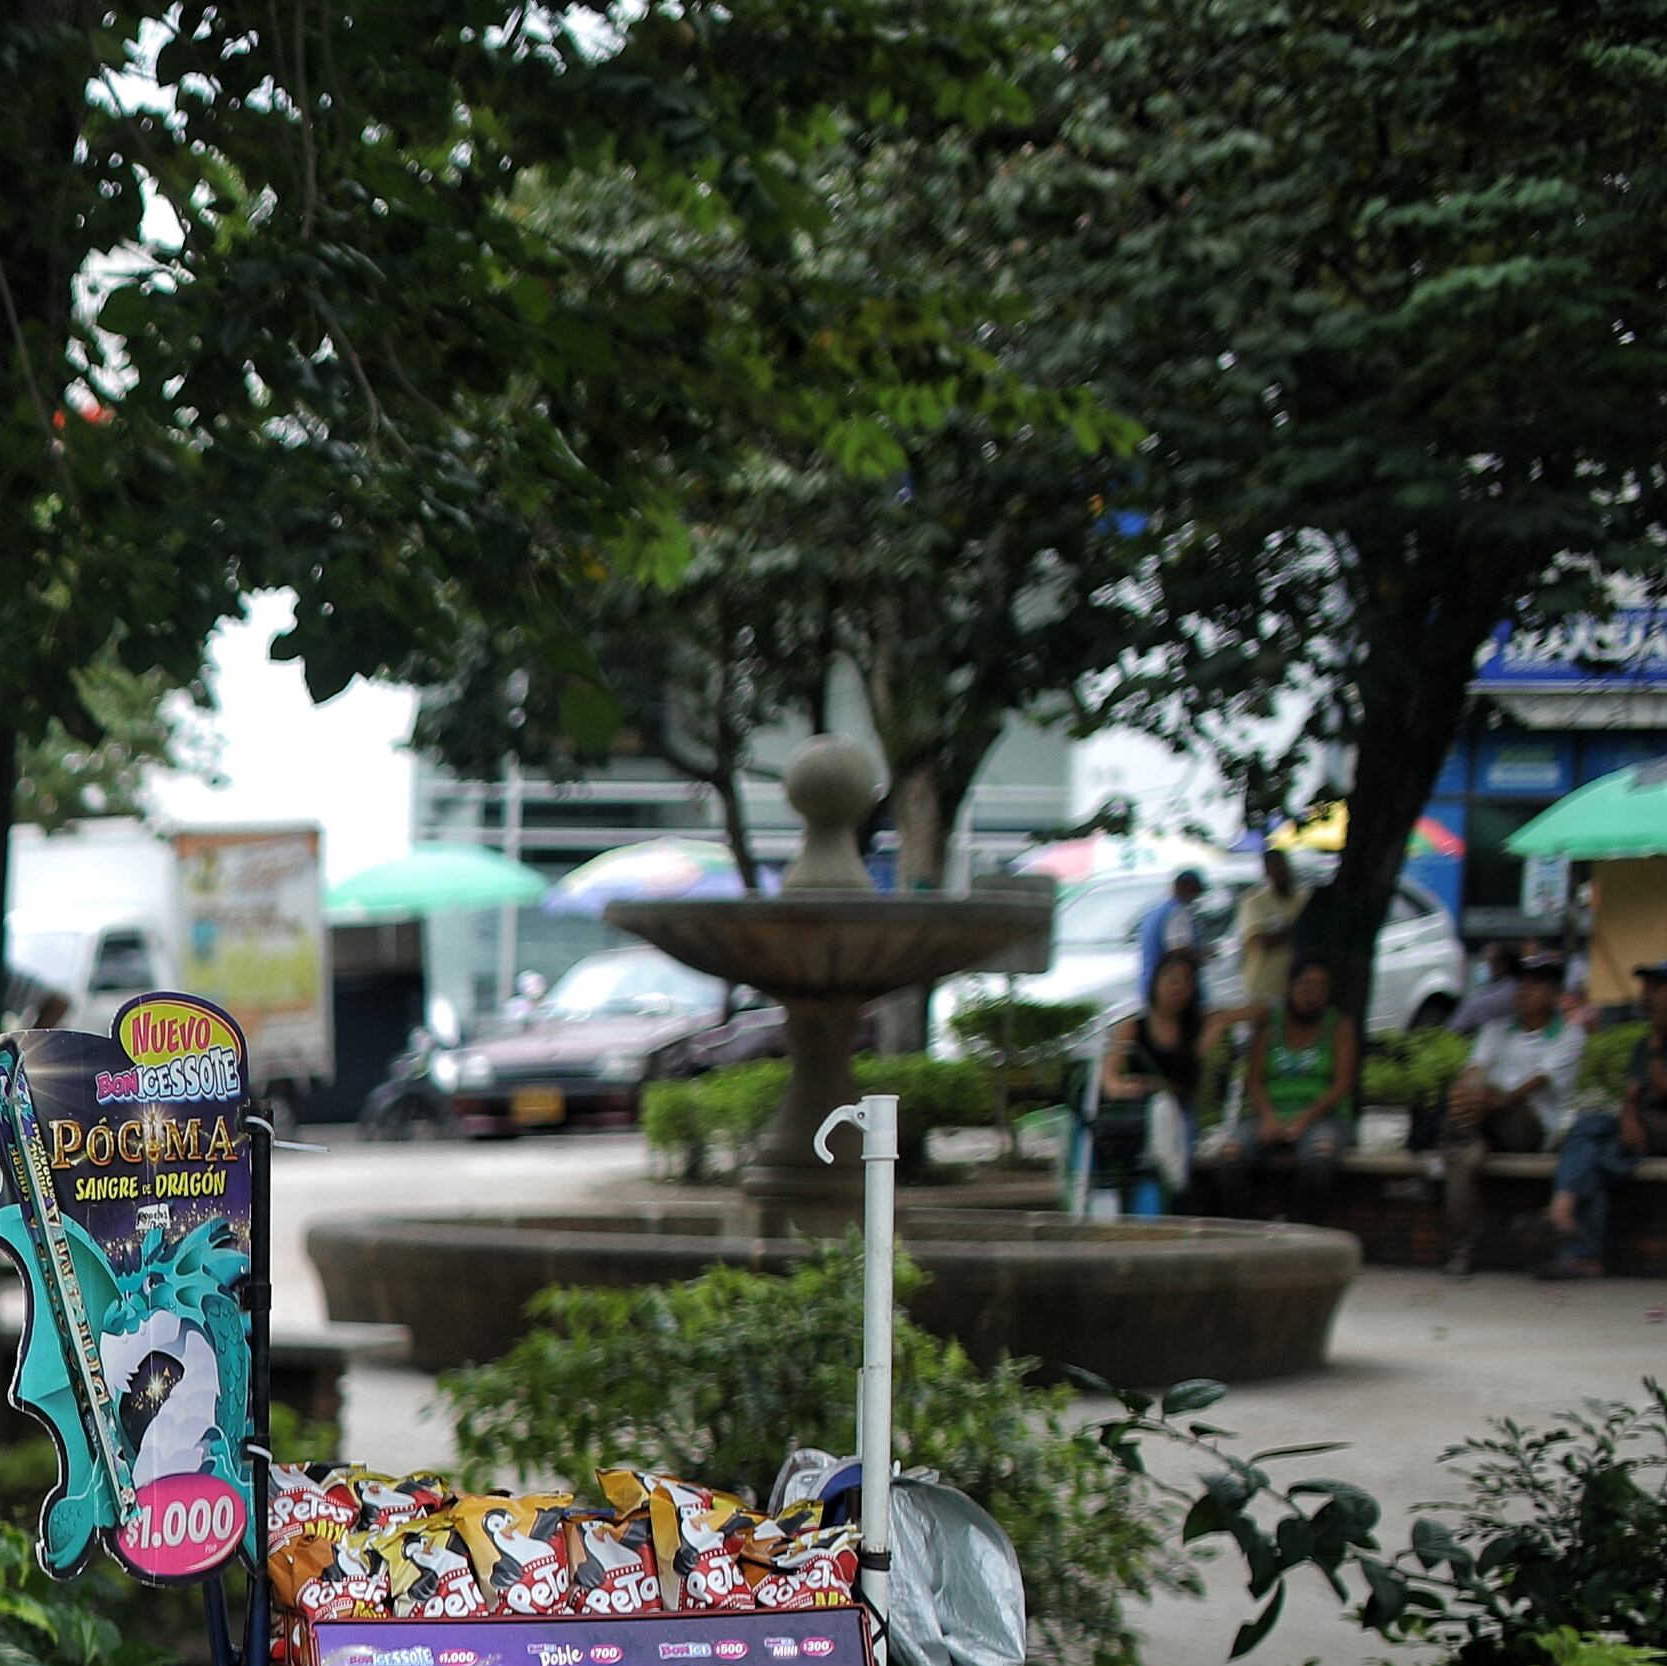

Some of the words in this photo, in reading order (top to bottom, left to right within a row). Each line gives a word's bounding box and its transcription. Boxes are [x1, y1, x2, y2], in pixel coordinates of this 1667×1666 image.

[131, 1010, 212, 1057] NUEVO
[95, 1046, 242, 1105] BONICESSOTE
[75, 1176, 138, 1201] SANGRE
[155, 1164, 227, 1198] DRAGÓN
[125, 1494, 234, 1549] $1.000
[772, 1645, 798, 1657] MINI
